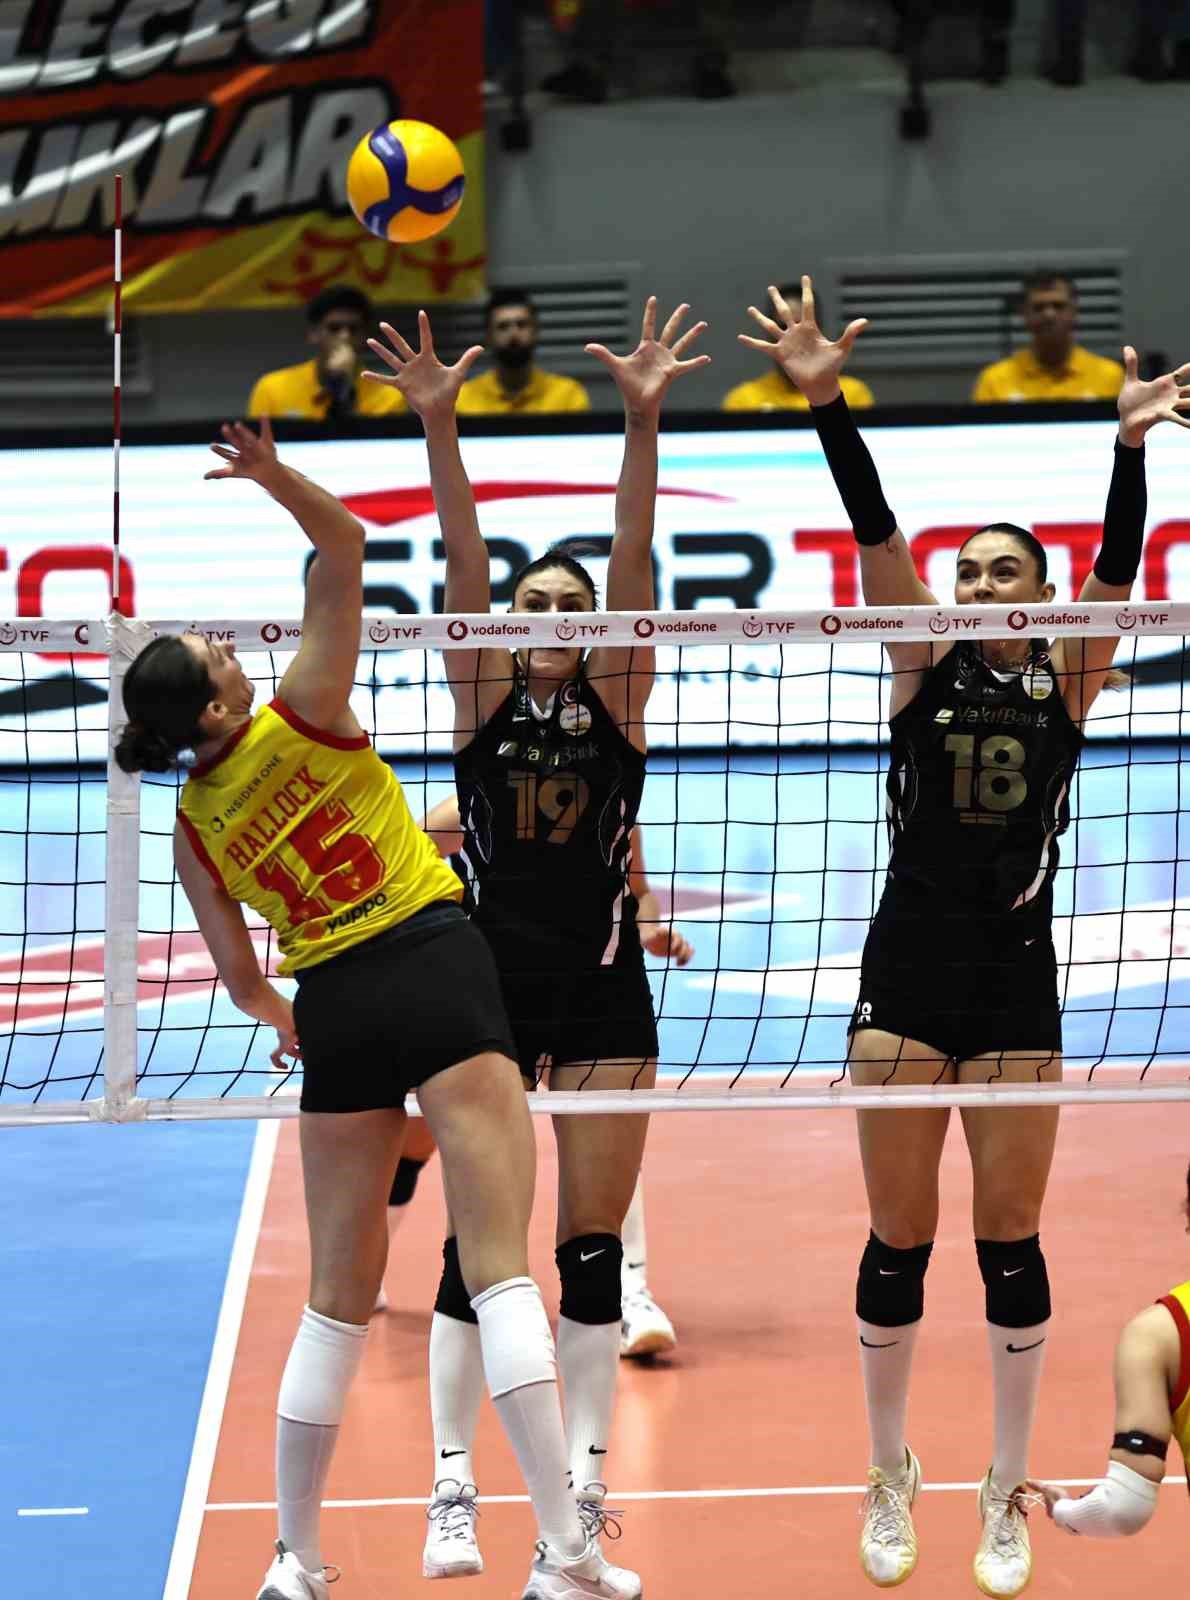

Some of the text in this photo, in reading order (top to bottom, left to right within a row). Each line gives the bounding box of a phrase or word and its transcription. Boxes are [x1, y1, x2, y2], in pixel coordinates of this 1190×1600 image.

[20, 630, 49, 642] TVF
[206, 630, 236, 642] TVF
[392, 612, 1168, 639] TVF vodafone TVF vodafone TVF vodafone TVF vodafone TVF
[223, 753, 282, 819] INSIDER ONE
[507, 770, 591, 843] 19
[944, 734, 1028, 811] 18
[226, 765, 327, 870] HALLOCK
[255, 798, 386, 927] 15
